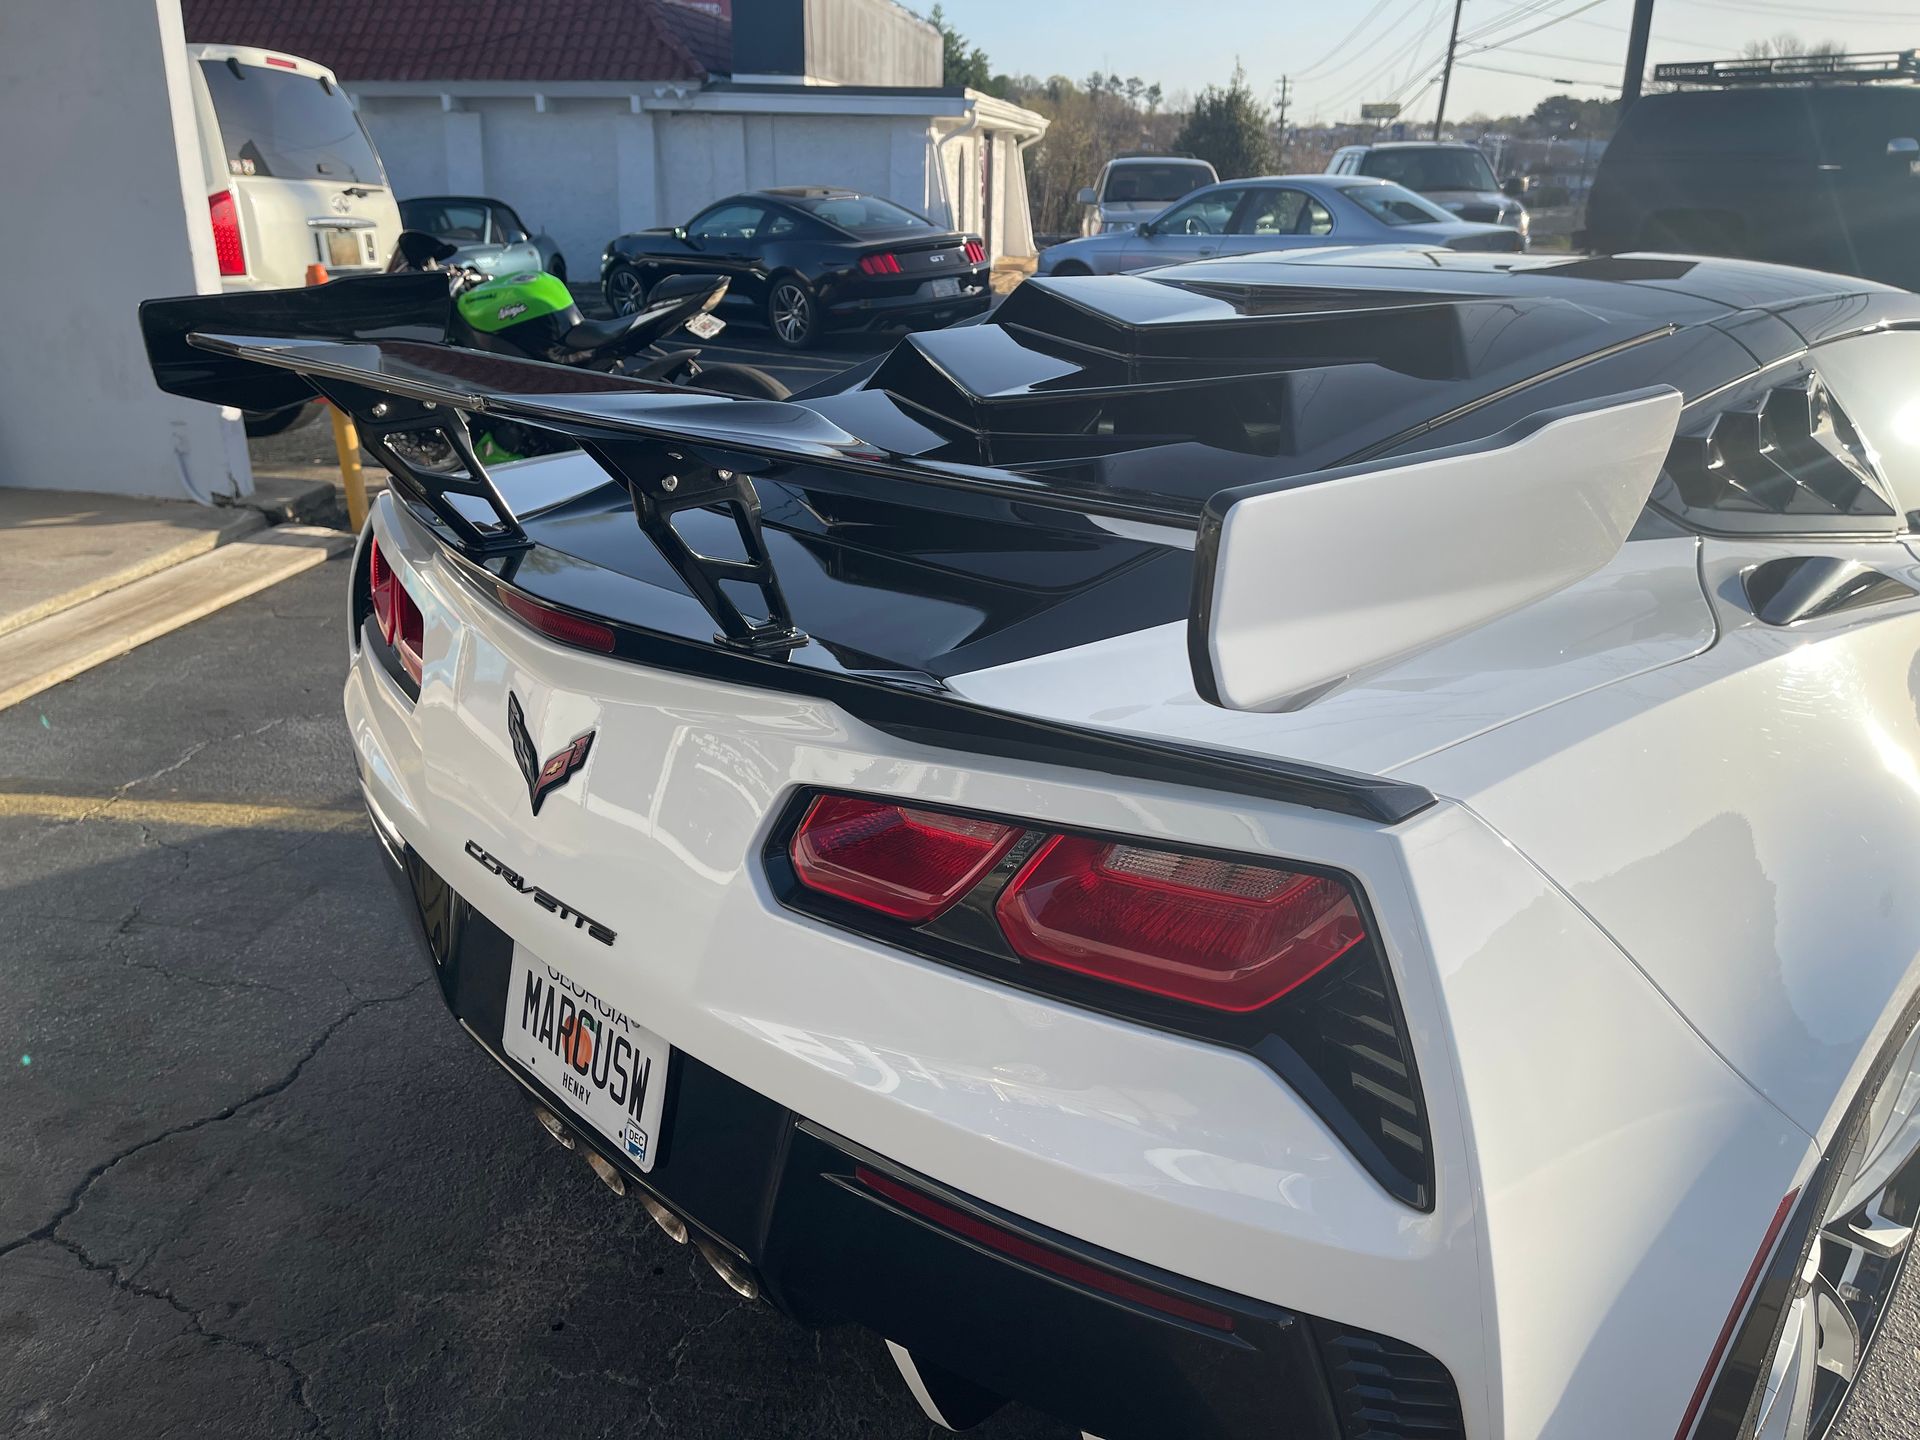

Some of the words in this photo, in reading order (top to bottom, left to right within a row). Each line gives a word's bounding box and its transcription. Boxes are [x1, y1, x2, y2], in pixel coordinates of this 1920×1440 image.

[929, 254, 945, 263] GT
[464, 839, 618, 947] CORVETTE
[521, 969, 652, 1124] MARCUSW
[562, 1071, 592, 1106] HENRY
[628, 1129, 645, 1147] DEC
